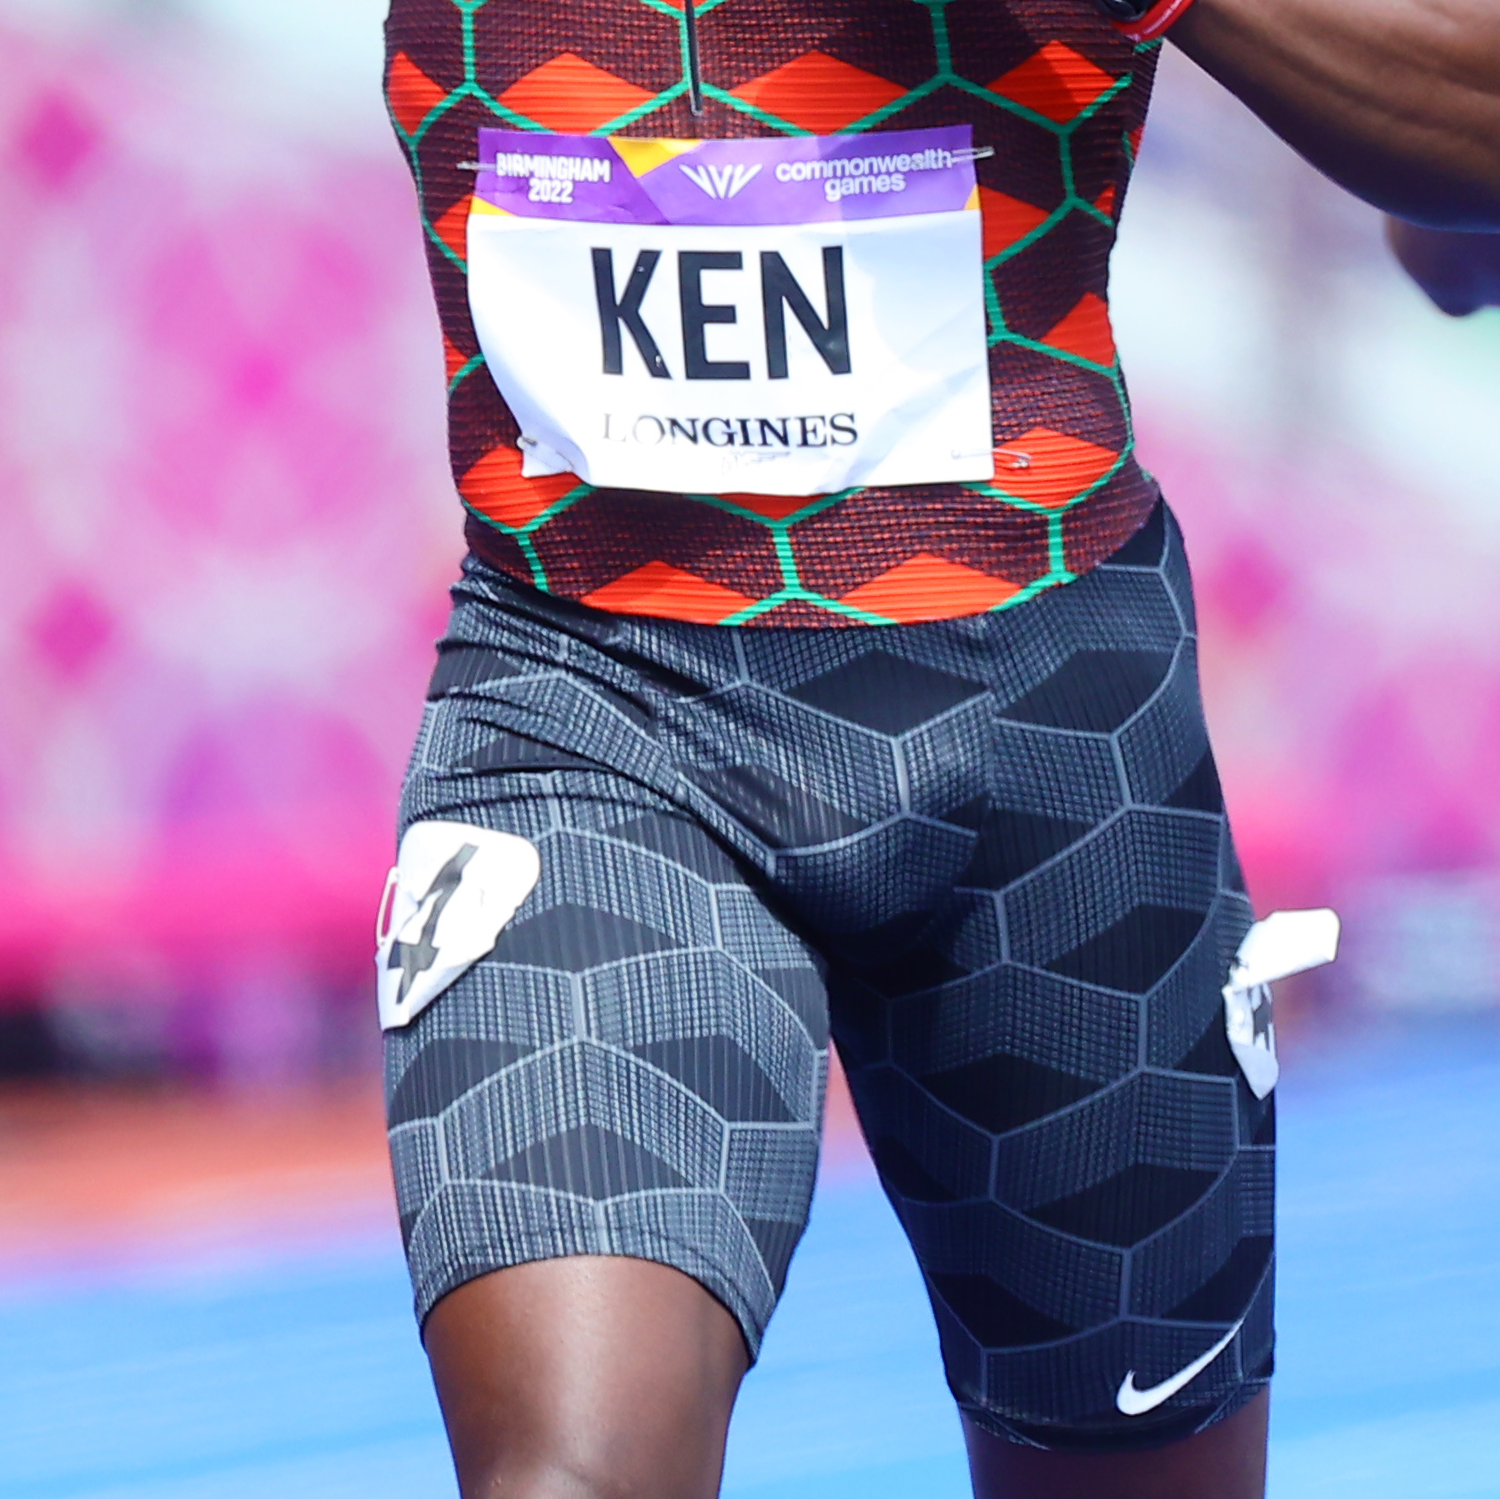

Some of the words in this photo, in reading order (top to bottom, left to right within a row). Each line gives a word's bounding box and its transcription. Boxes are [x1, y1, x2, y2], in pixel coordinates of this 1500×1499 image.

[496, 152, 612, 183] BIRMINGHAM
[776, 149, 953, 182] commonwealth
[528, 178, 574, 204] 2022
[824, 173, 907, 202] games
[590, 245, 853, 381] KEN
[602, 412, 859, 448] LONGINES
